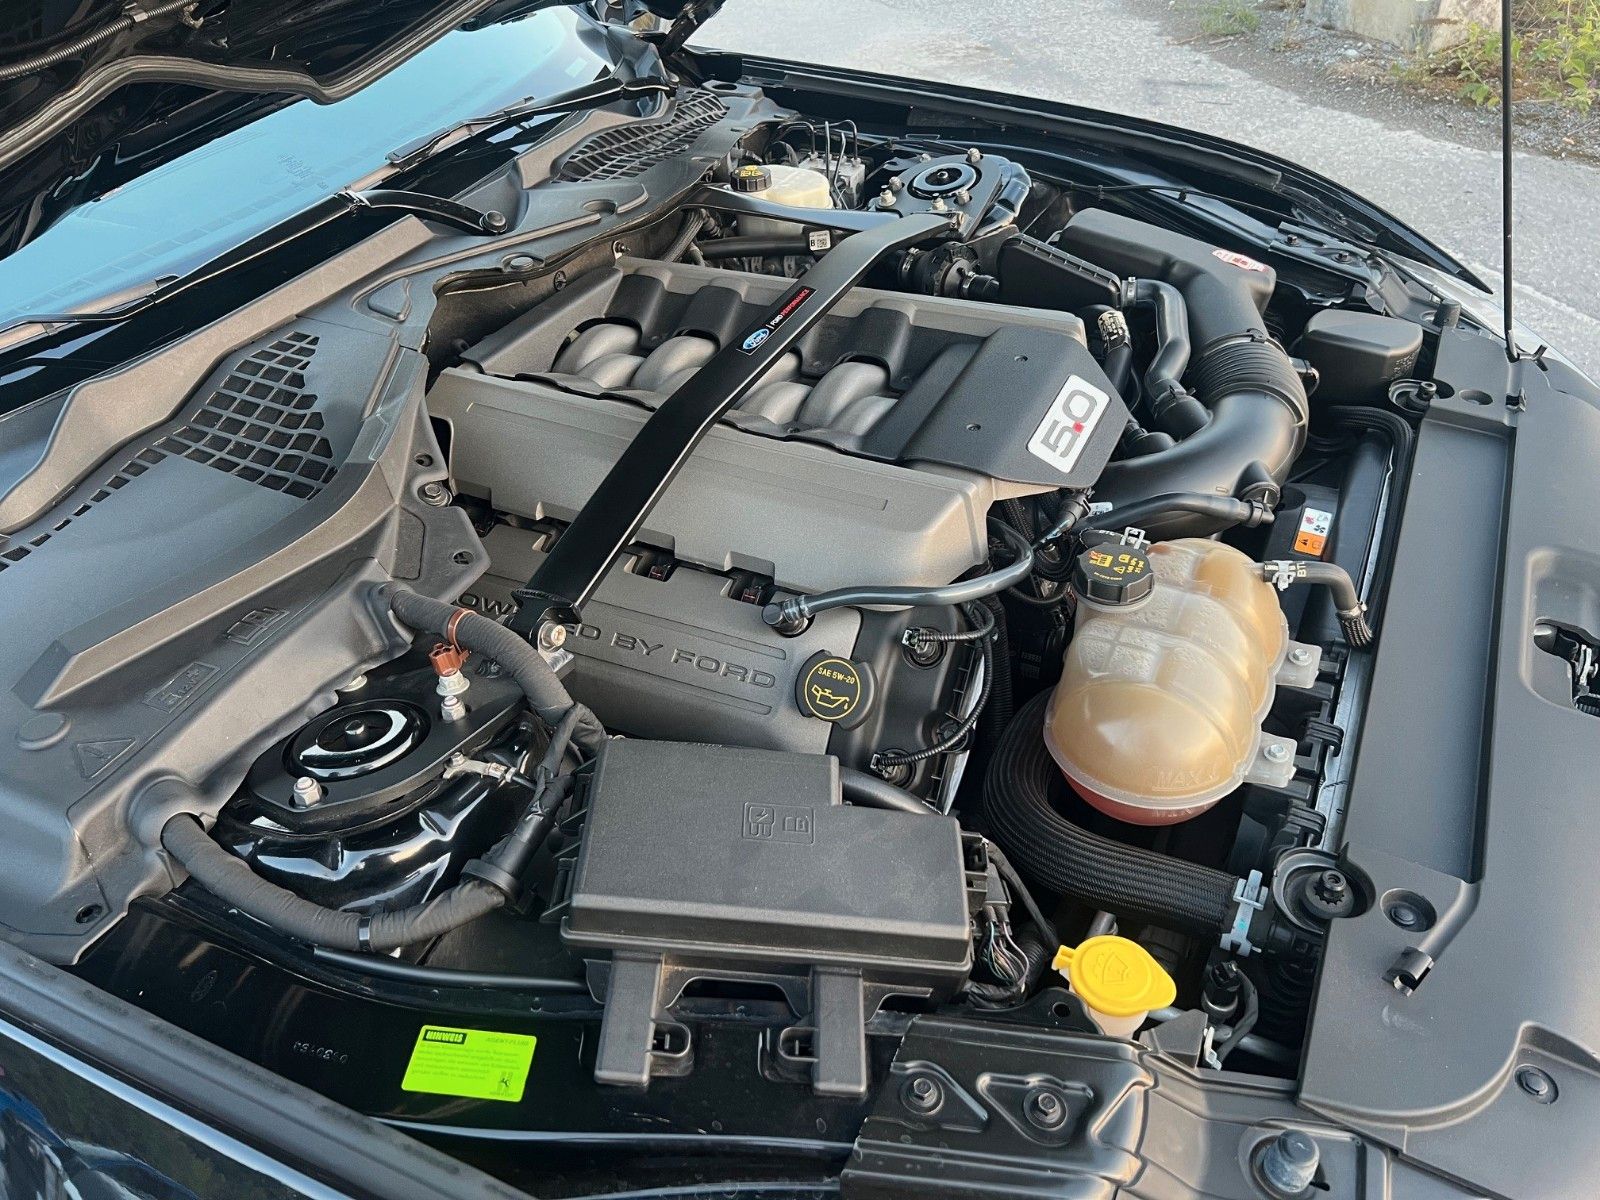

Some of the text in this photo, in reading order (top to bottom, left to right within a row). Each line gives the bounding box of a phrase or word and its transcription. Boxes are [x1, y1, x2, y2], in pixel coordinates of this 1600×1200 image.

[1041, 389, 1098, 459] 5.0
[610, 632, 664, 656] BY
[670, 648, 776, 689] FORD
[817, 667, 856, 685] SAE 5W-20
